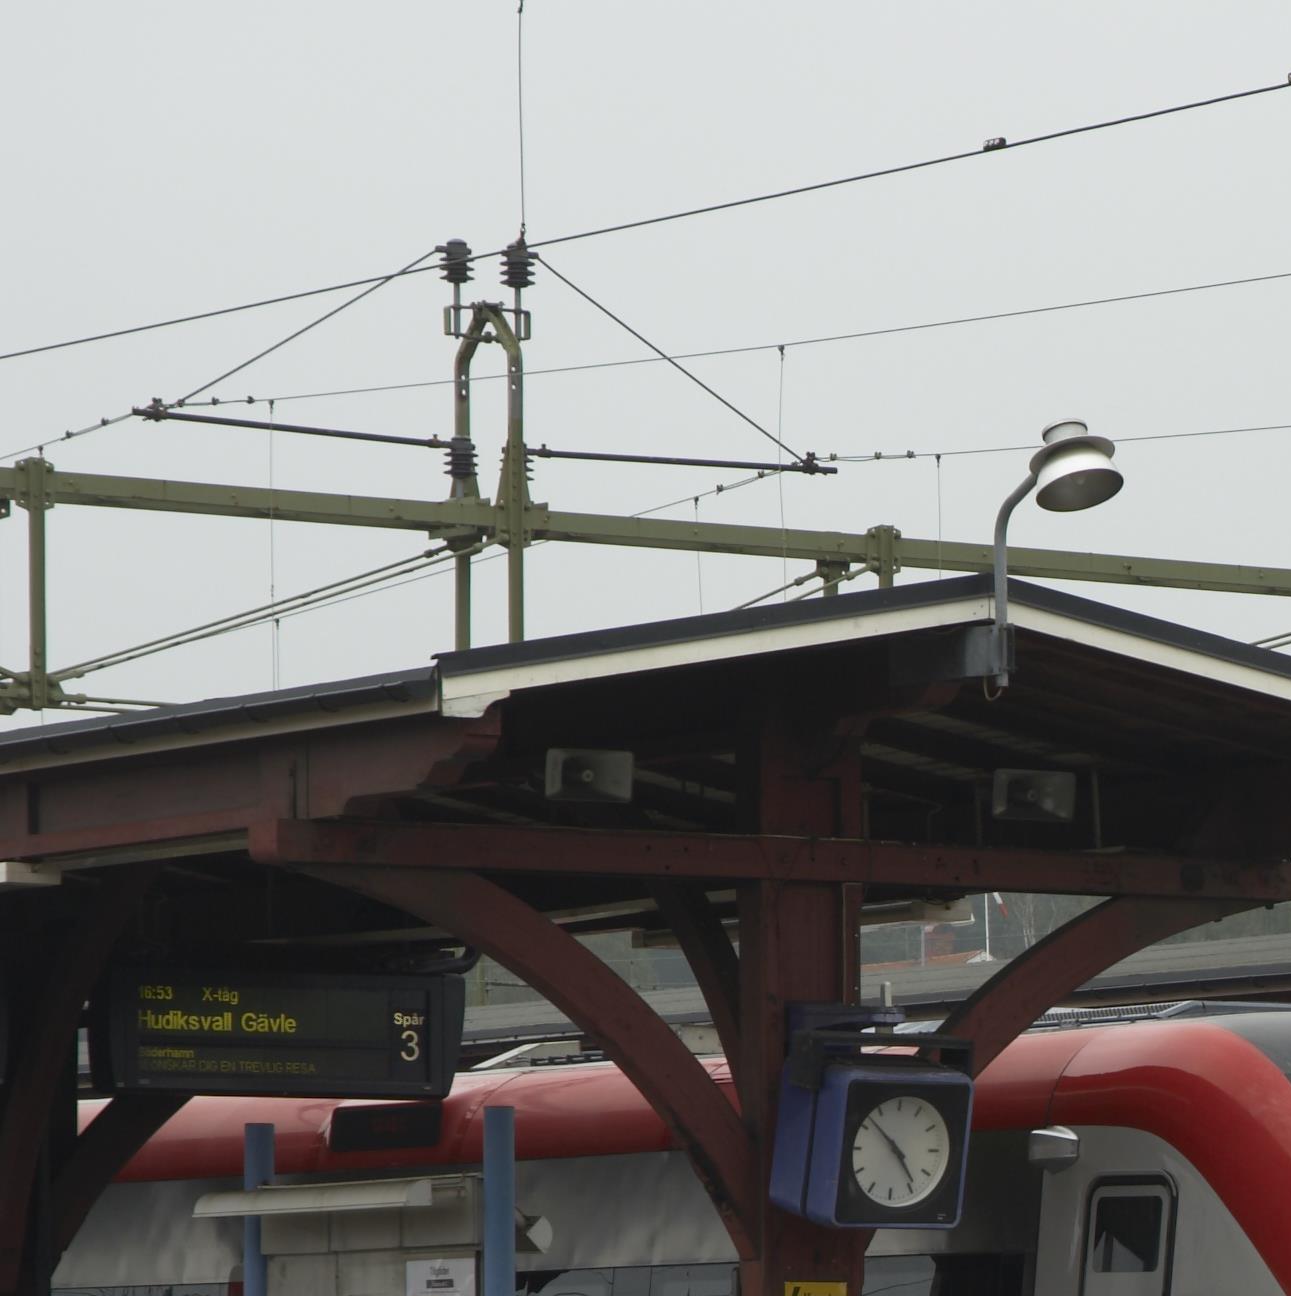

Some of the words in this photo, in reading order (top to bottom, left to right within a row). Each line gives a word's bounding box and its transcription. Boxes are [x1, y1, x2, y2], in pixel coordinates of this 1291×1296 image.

[138, 984, 174, 1001] 16:53
[137, 1009, 233, 1032] Hudiksvall
[241, 1012, 298, 1034] Gävle
[394, 1012, 424, 1027] Spår
[401, 1030, 420, 1061] 3
